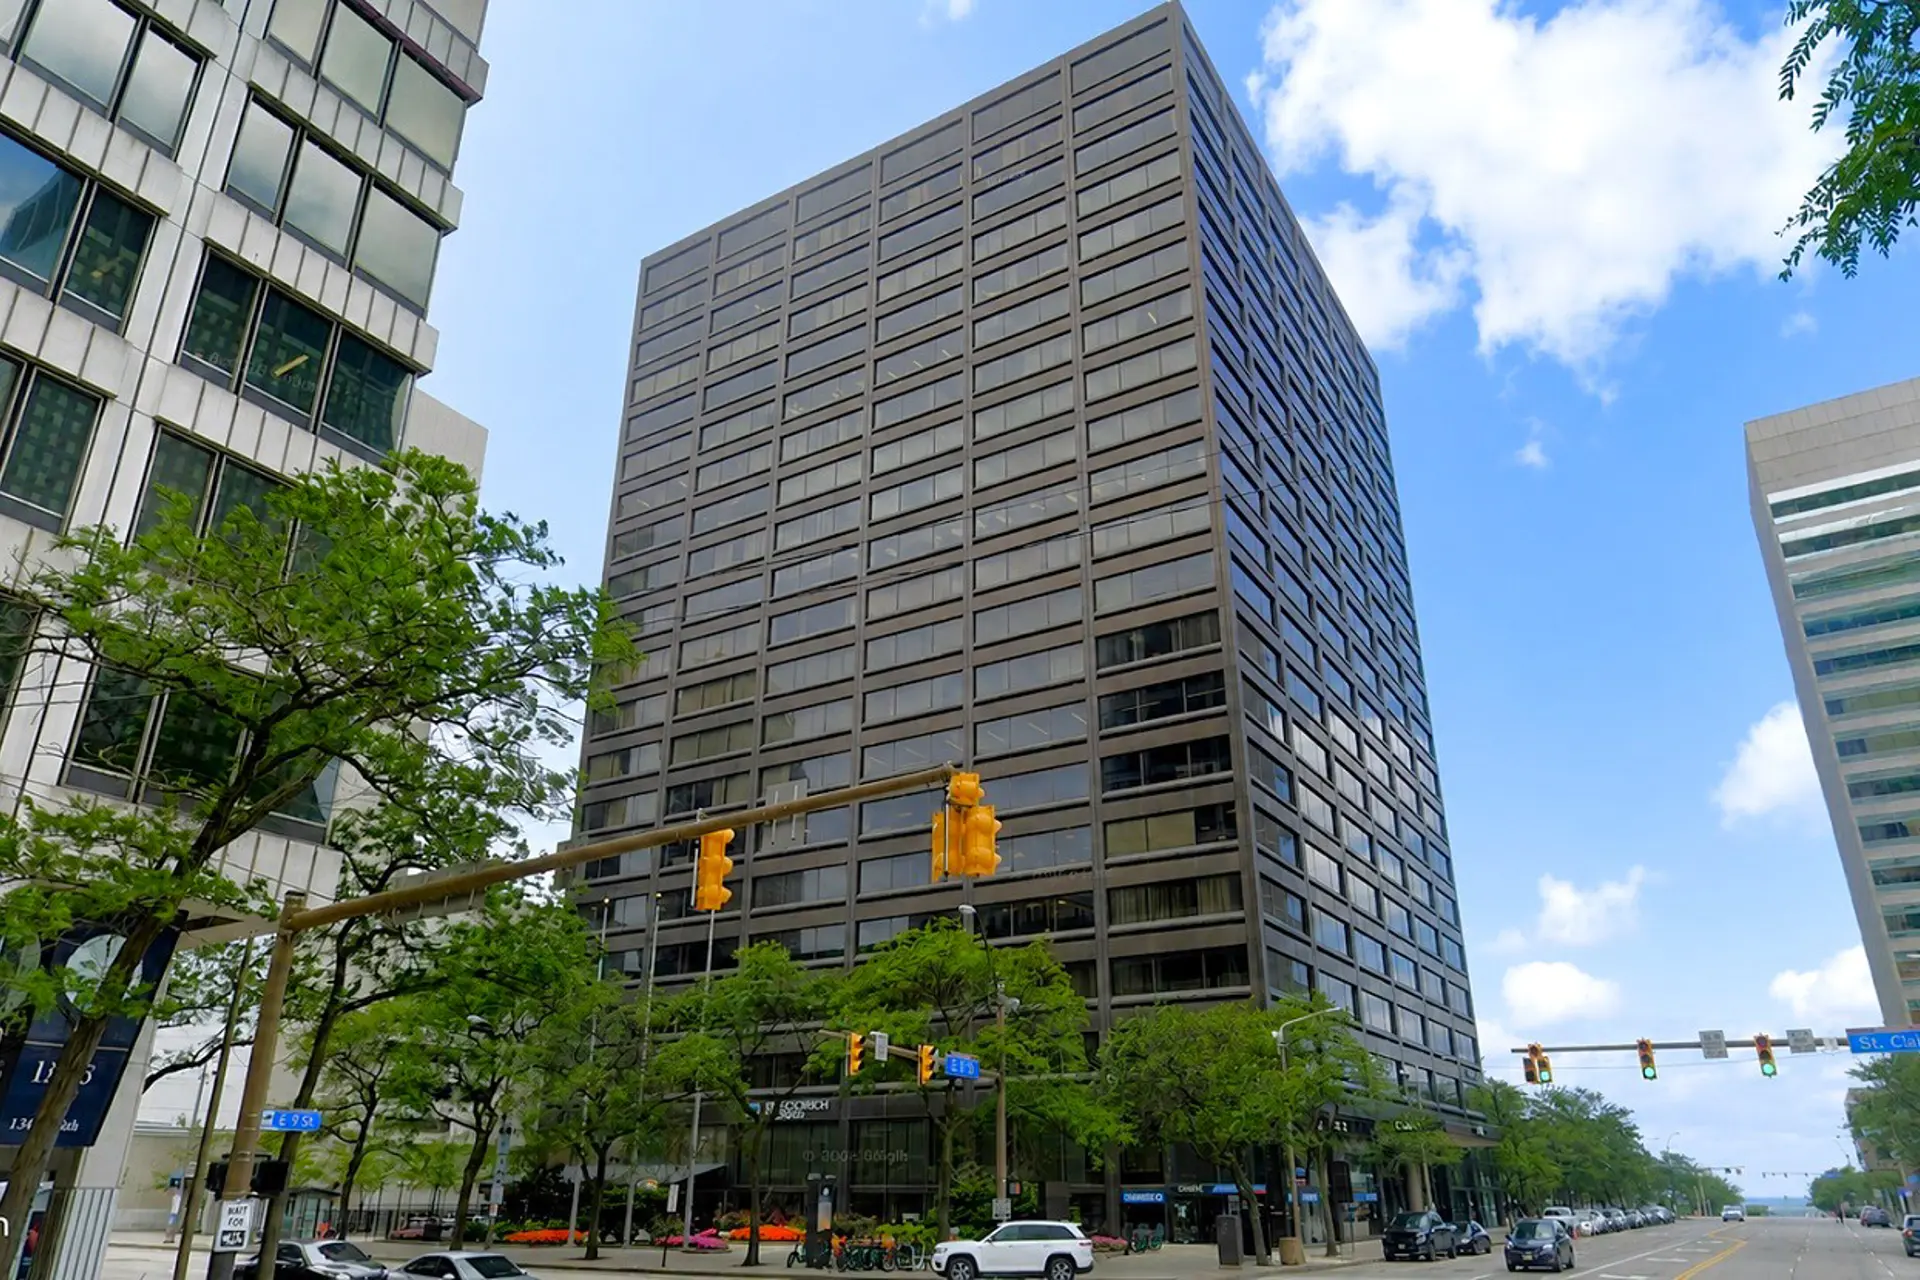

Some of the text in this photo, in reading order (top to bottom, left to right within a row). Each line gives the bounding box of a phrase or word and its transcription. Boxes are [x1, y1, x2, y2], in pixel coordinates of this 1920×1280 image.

[1858, 1035, 1884, 1049] St.
[279, 1113, 287, 1127] E
[291, 1113, 299, 1127] 9
[228, 1205, 248, 1215] WAIT
[228, 1217, 244, 1227] FOR
